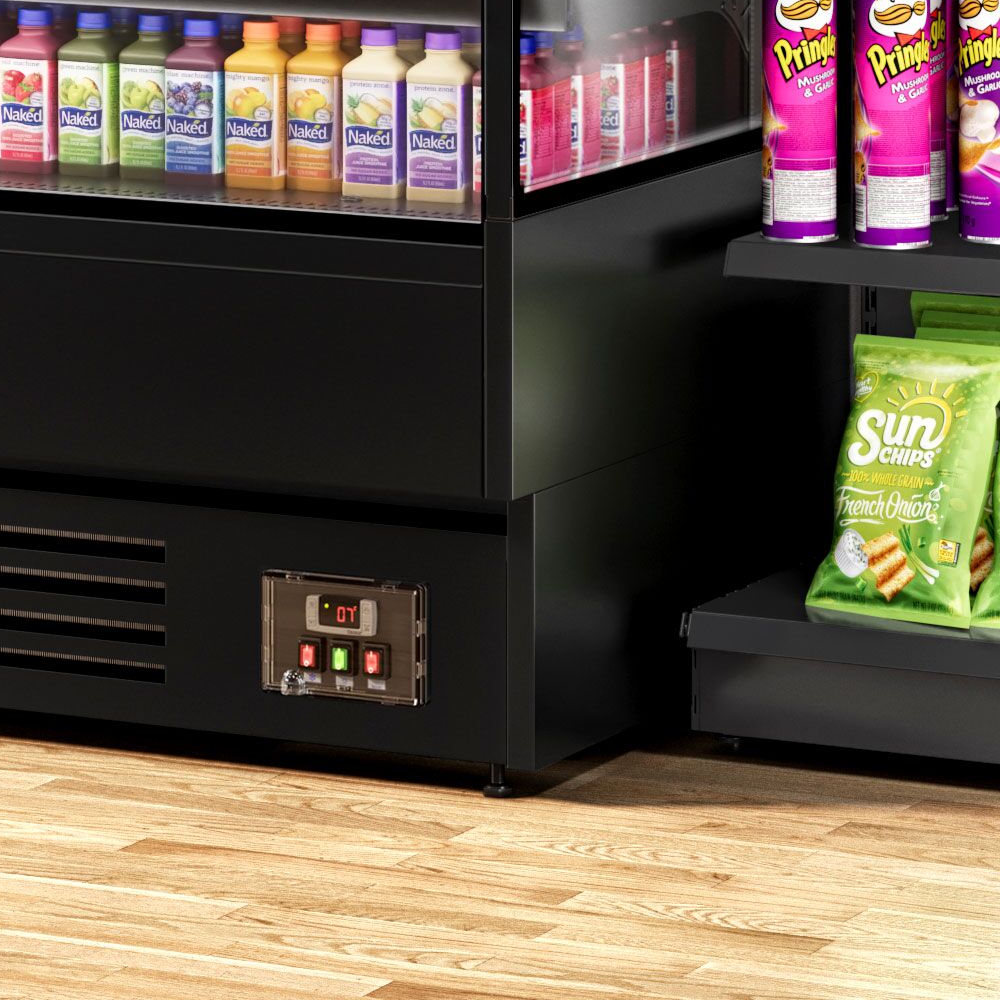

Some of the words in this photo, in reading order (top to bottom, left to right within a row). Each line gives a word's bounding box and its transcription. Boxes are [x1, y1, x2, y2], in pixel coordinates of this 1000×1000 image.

[804, 88, 814, 98] &
[898, 93, 907, 103] &
[968, 88, 976, 98] &
[3, 106, 43, 123] Naked
[61, 110, 99, 127] Naked
[123, 113, 162, 130] Naked
[167, 119, 208, 135] Naked
[226, 121, 267, 138] Naked
[288, 123, 327, 140] Naked
[348, 129, 391, 146] Naked
[412, 133, 456, 150] Naked
[848, 409, 948, 466] Sun
[879, 446, 935, 468] CHIPS
[850, 470, 870, 482] 100%
[871, 472, 898, 486] WHOLE
[898, 474, 923, 489] GRAIN
[836, 486, 885, 520] French
[885, 491, 936, 522] Onion
